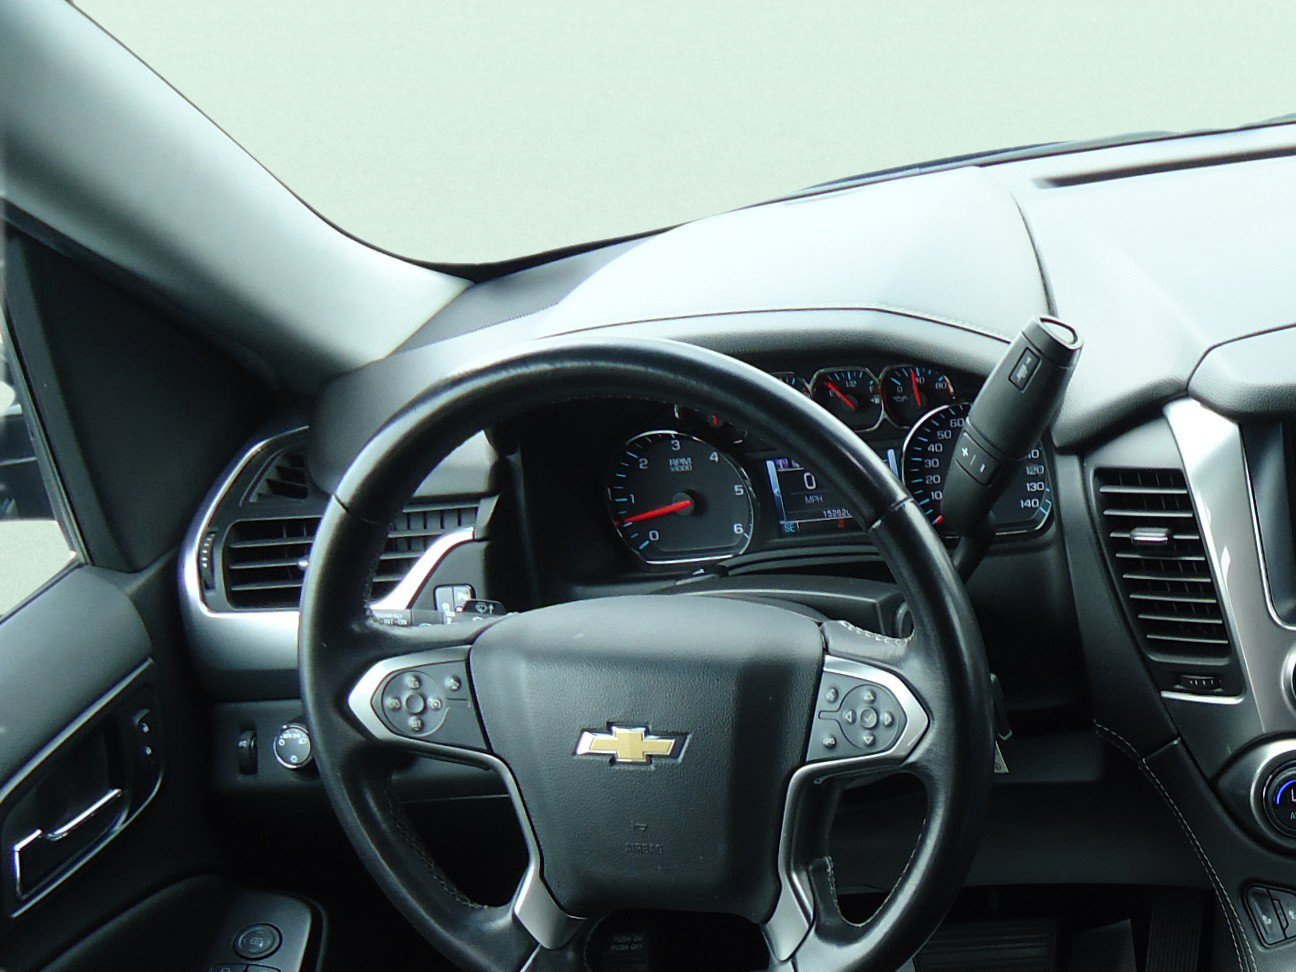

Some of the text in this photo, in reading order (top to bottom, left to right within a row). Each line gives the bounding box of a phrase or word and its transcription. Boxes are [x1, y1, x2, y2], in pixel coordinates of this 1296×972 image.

[950, 418, 965, 427] 60
[937, 430, 952, 439] 50
[670, 440, 680, 450] 3
[928, 444, 943, 452] 40
[710, 451, 718, 462] 4
[639, 458, 648, 469] 2
[924, 458, 939, 468] 30
[1026, 465, 1044, 475] 120
[804, 472, 816, 490] 0
[925, 474, 940, 484] 20
[734, 485, 744, 496] 5
[1026, 482, 1045, 491] 130
[930, 491, 943, 500] 10
[1020, 499, 1039, 508] 140
[734, 524, 744, 534] 6
[649, 530, 659, 540] 0
